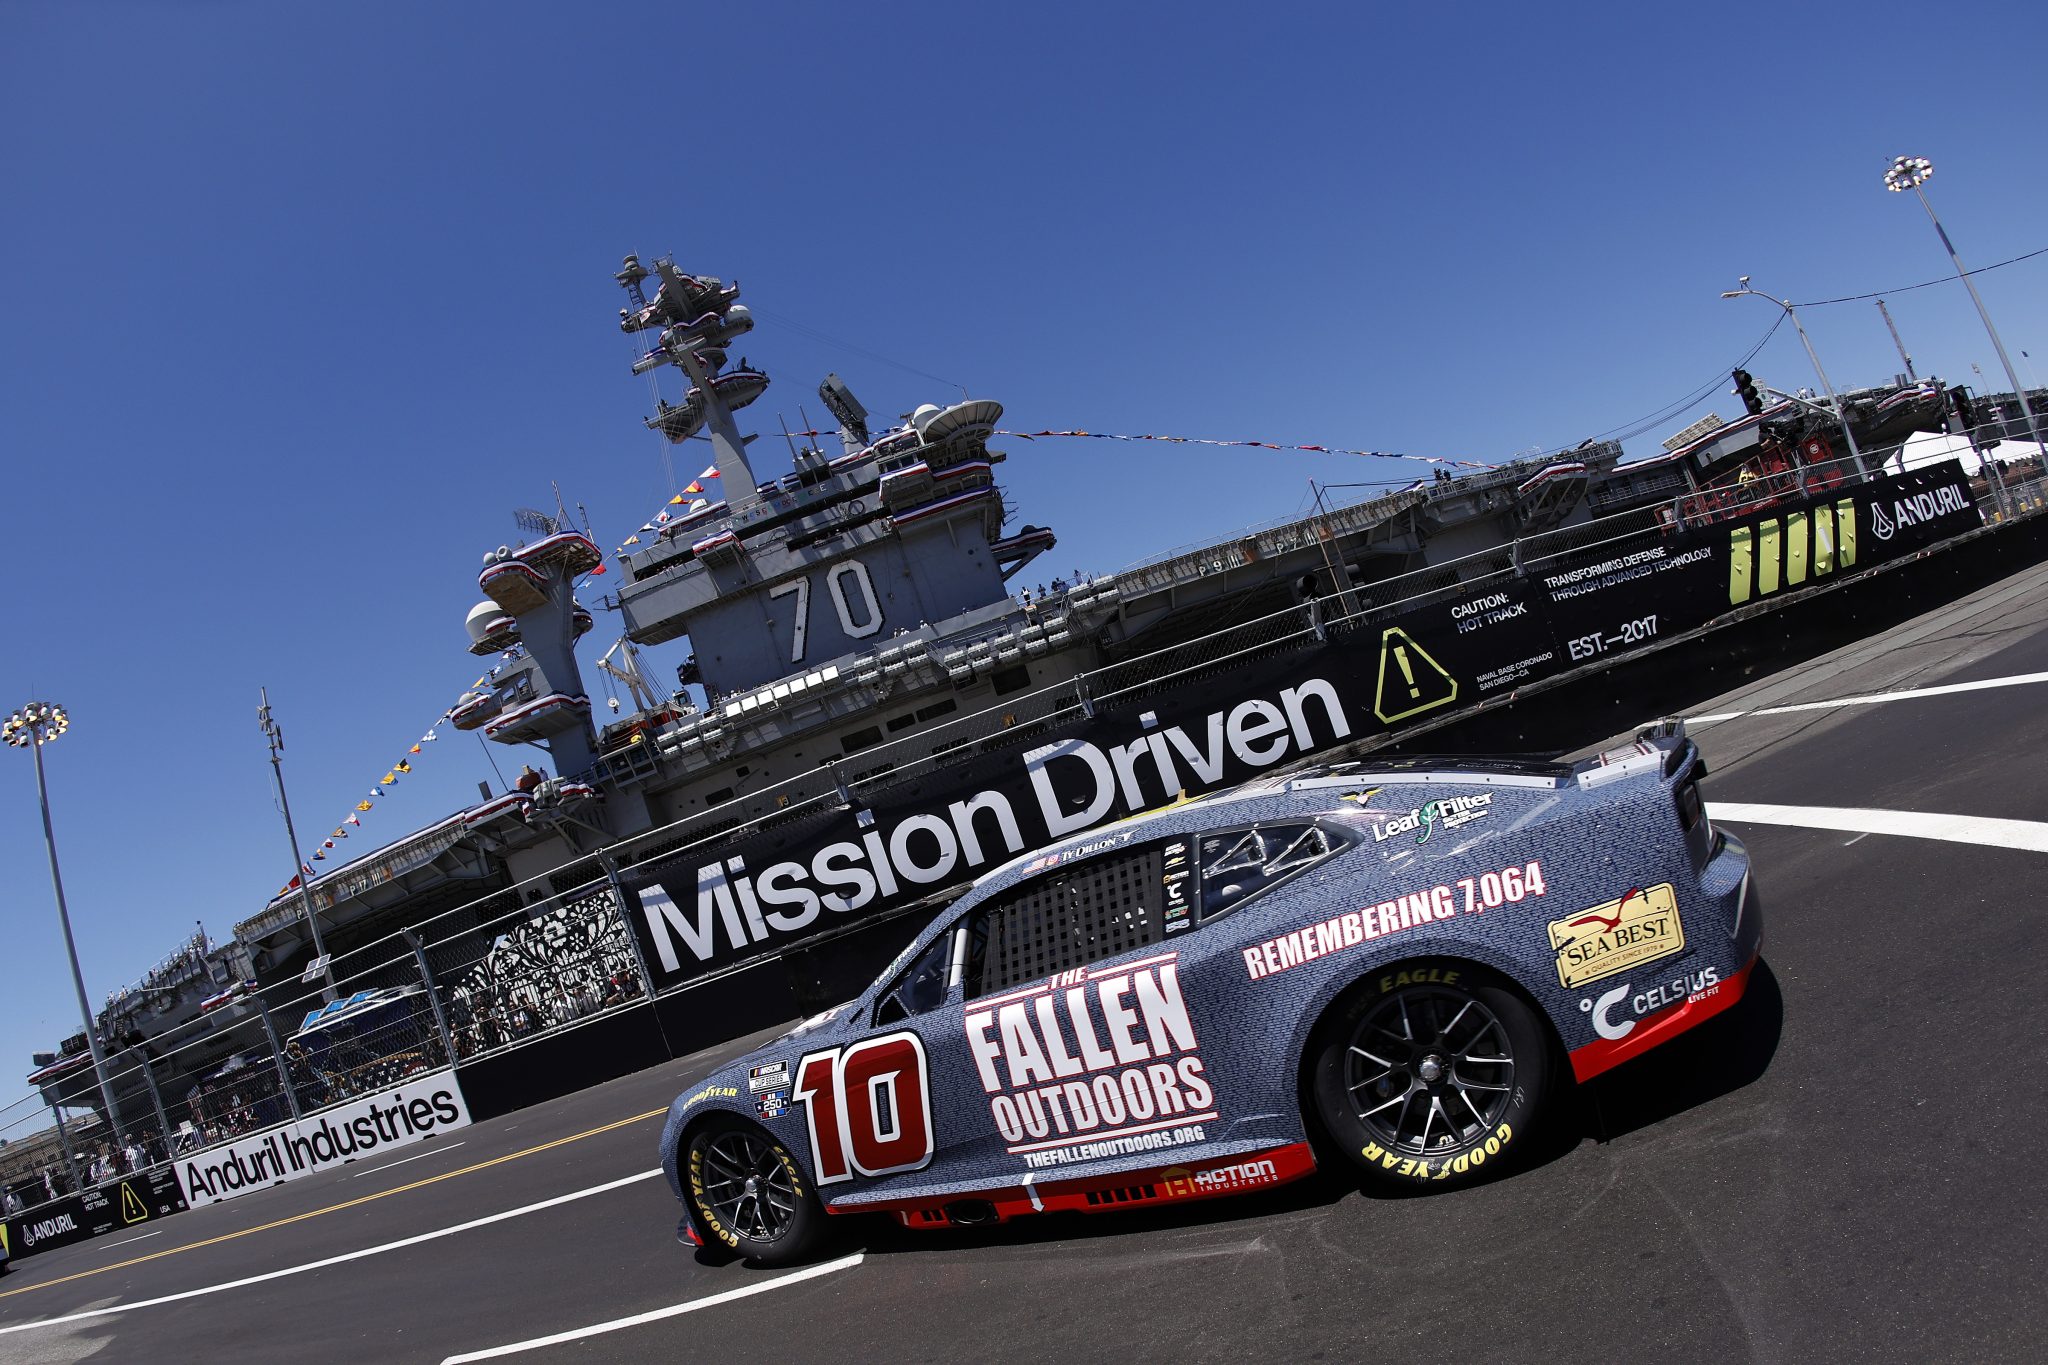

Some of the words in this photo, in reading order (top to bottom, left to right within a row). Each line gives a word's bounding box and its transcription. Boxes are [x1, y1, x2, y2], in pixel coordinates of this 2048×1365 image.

[1894, 483, 1971, 528] ANDURIL
[1544, 558, 1624, 588] TRANSFORMING
[1625, 547, 1666, 567] DEFENSE
[1550, 580, 1601, 602] THROUGH
[1602, 566, 1652, 589] ADVANCED
[1652, 548, 1712, 573] TECHNOLOGY
[768, 559, 885, 663] 70
[1451, 592, 1509, 619] CAUTION:
[1457, 616, 1485, 634] HOT
[1484, 602, 1527, 625] TRACK
[1476, 668, 1498, 683] NAVAL
[1498, 663, 1515, 677] BASE
[1515, 652, 1553, 672] CORONADO
[1479, 680, 1494, 691] SAN
[637, 790, 1025, 974] Mission
[1024, 678, 1351, 838] Driven
[1371, 808, 1421, 842] Leaf
[1438, 791, 1494, 817] Filter
[1075, 837, 1116, 856] DILLON
[1242, 884, 1455, 981] REMEMBERING
[1457, 860, 1546, 914] 7,064
[1567, 937, 1611, 966] SEA
[1614, 918, 1669, 948] BEST
[1591, 957, 1621, 972] QUALITY
[1622, 948, 1642, 960] SINCE
[1050, 967, 1088, 989] THE
[1378, 968, 1462, 994] EAGLE
[1633, 966, 1719, 1014] CELSIUS
[1688, 992, 1706, 1004] LIVE
[1707, 986, 1719, 997] FIT
[964, 963, 1198, 1093] FALLEN
[755, 1078, 766, 1088] CUP
[766, 1074, 784, 1085] SERIES
[763, 1098, 782, 1111] 250
[794, 1028, 935, 1186] 10
[991, 1056, 1214, 1142] OUTDOORS
[186, 1138, 287, 1203] Anduril
[286, 1090, 460, 1171] Industries
[1024, 1126, 1205, 1168] THEFALLENOUTDOORS.ORG
[772, 1146, 804, 1198] EAGLE
[1195, 1159, 1276, 1186] ACTION
[1201, 1175, 1279, 1192] INDUSTRIES
[82, 1190, 103, 1203] CAUTION:
[84, 1202, 94, 1212] HOT
[94, 1197, 109, 1208] TRACK
[159, 1204, 171, 1214] USA
[34, 1213, 78, 1240] ANDURIL
